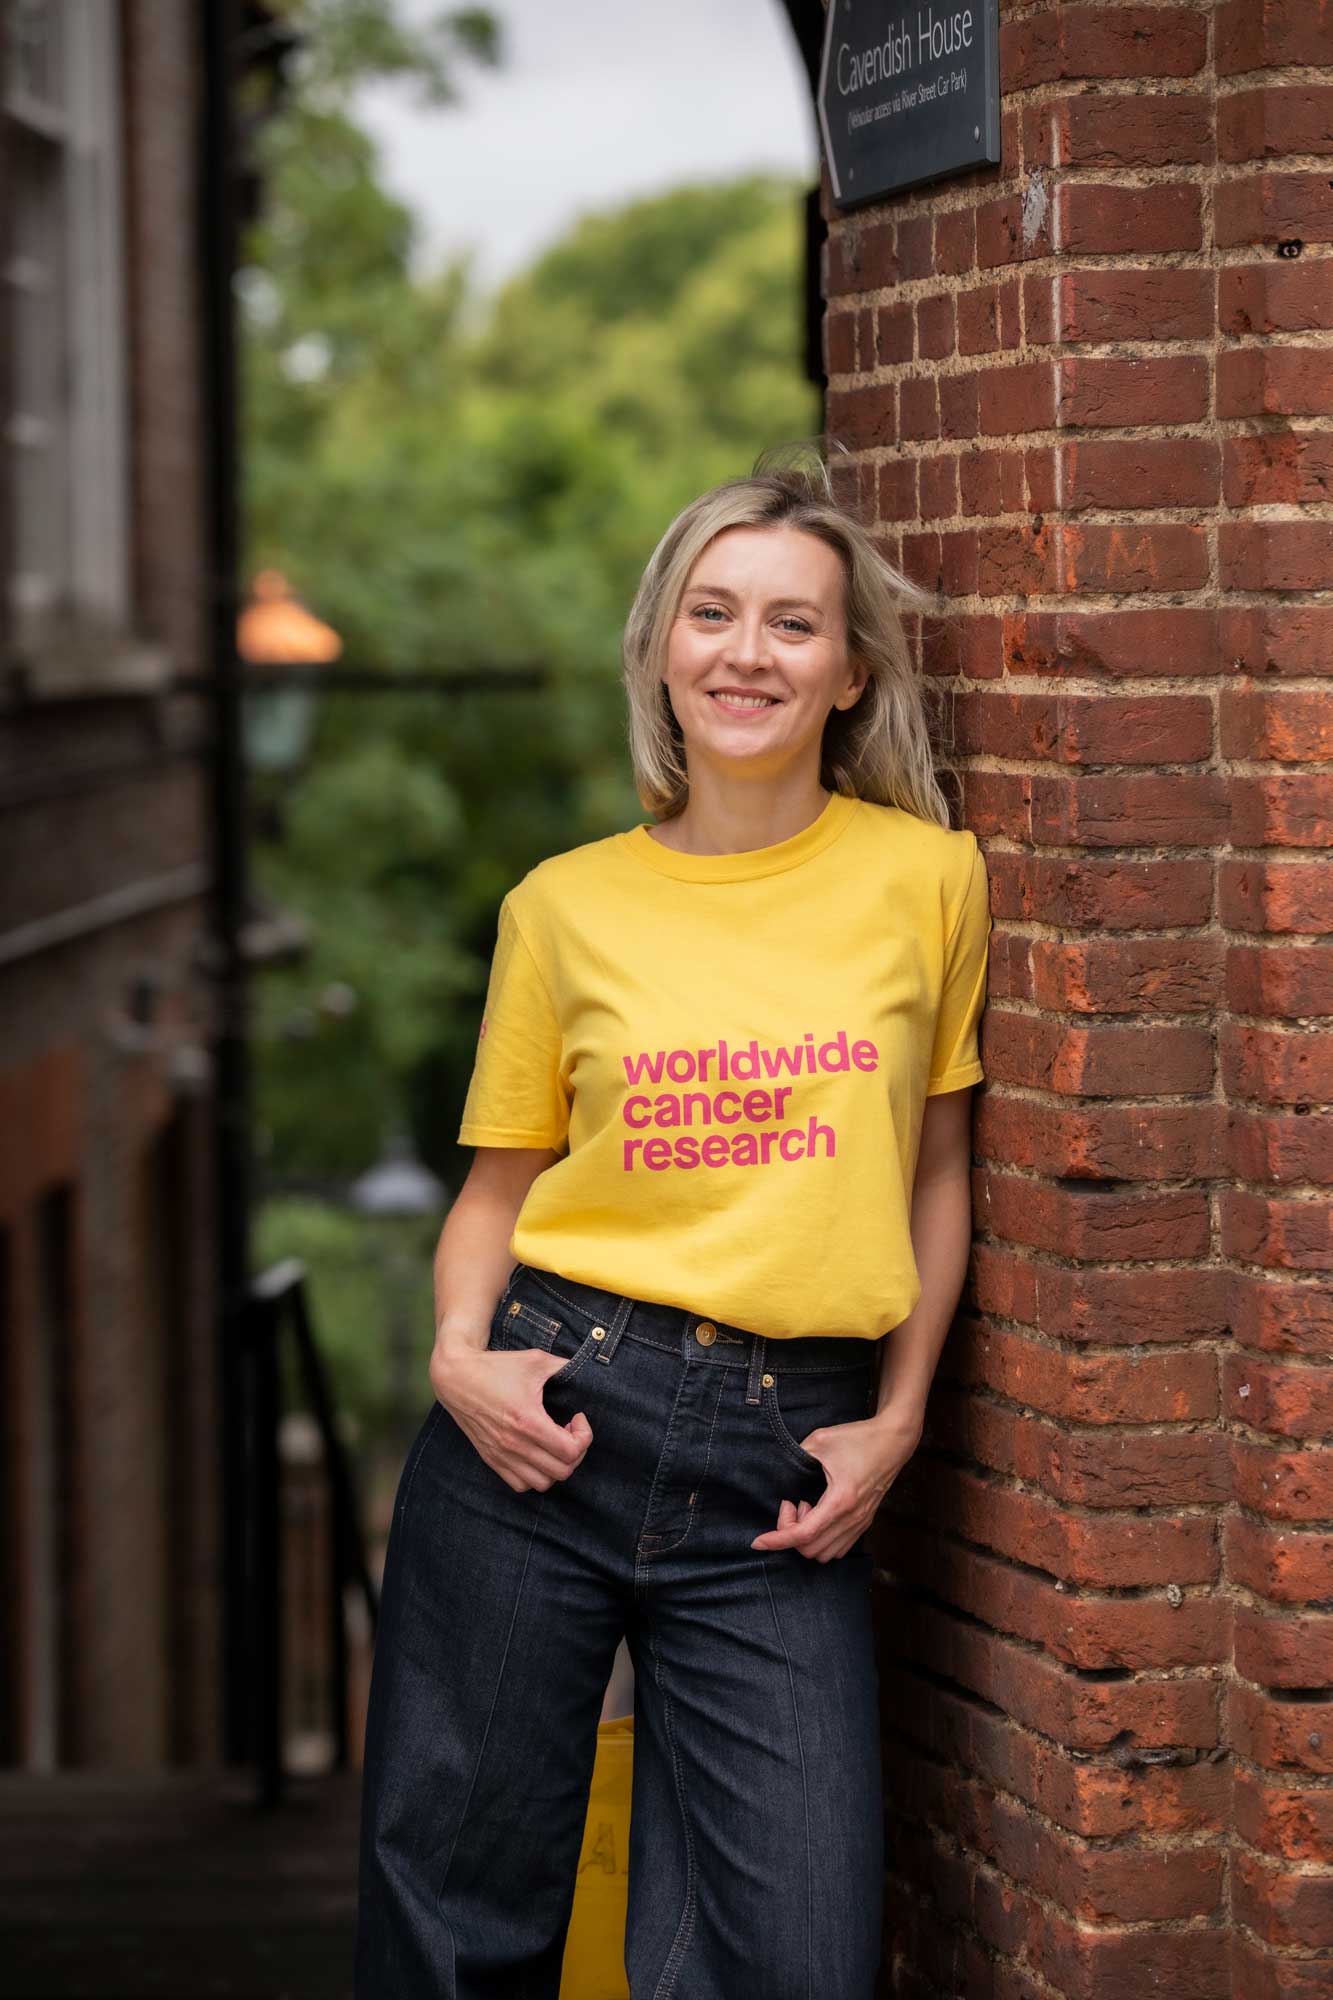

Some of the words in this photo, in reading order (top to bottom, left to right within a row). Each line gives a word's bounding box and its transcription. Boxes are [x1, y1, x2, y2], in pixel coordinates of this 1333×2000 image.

[837, 19, 911, 96] Cavendish
[918, 7, 973, 64] House
[874, 101, 892, 120] access
[892, 93, 901, 113] via
[901, 88, 917, 110] River
[918, 83, 936, 103] Street
[937, 76, 950, 97] Car
[950, 67, 967, 94] Park)
[623, 1031, 879, 1086] worldwide
[623, 1086, 793, 1129] cancer
[623, 1116, 836, 1171] research
